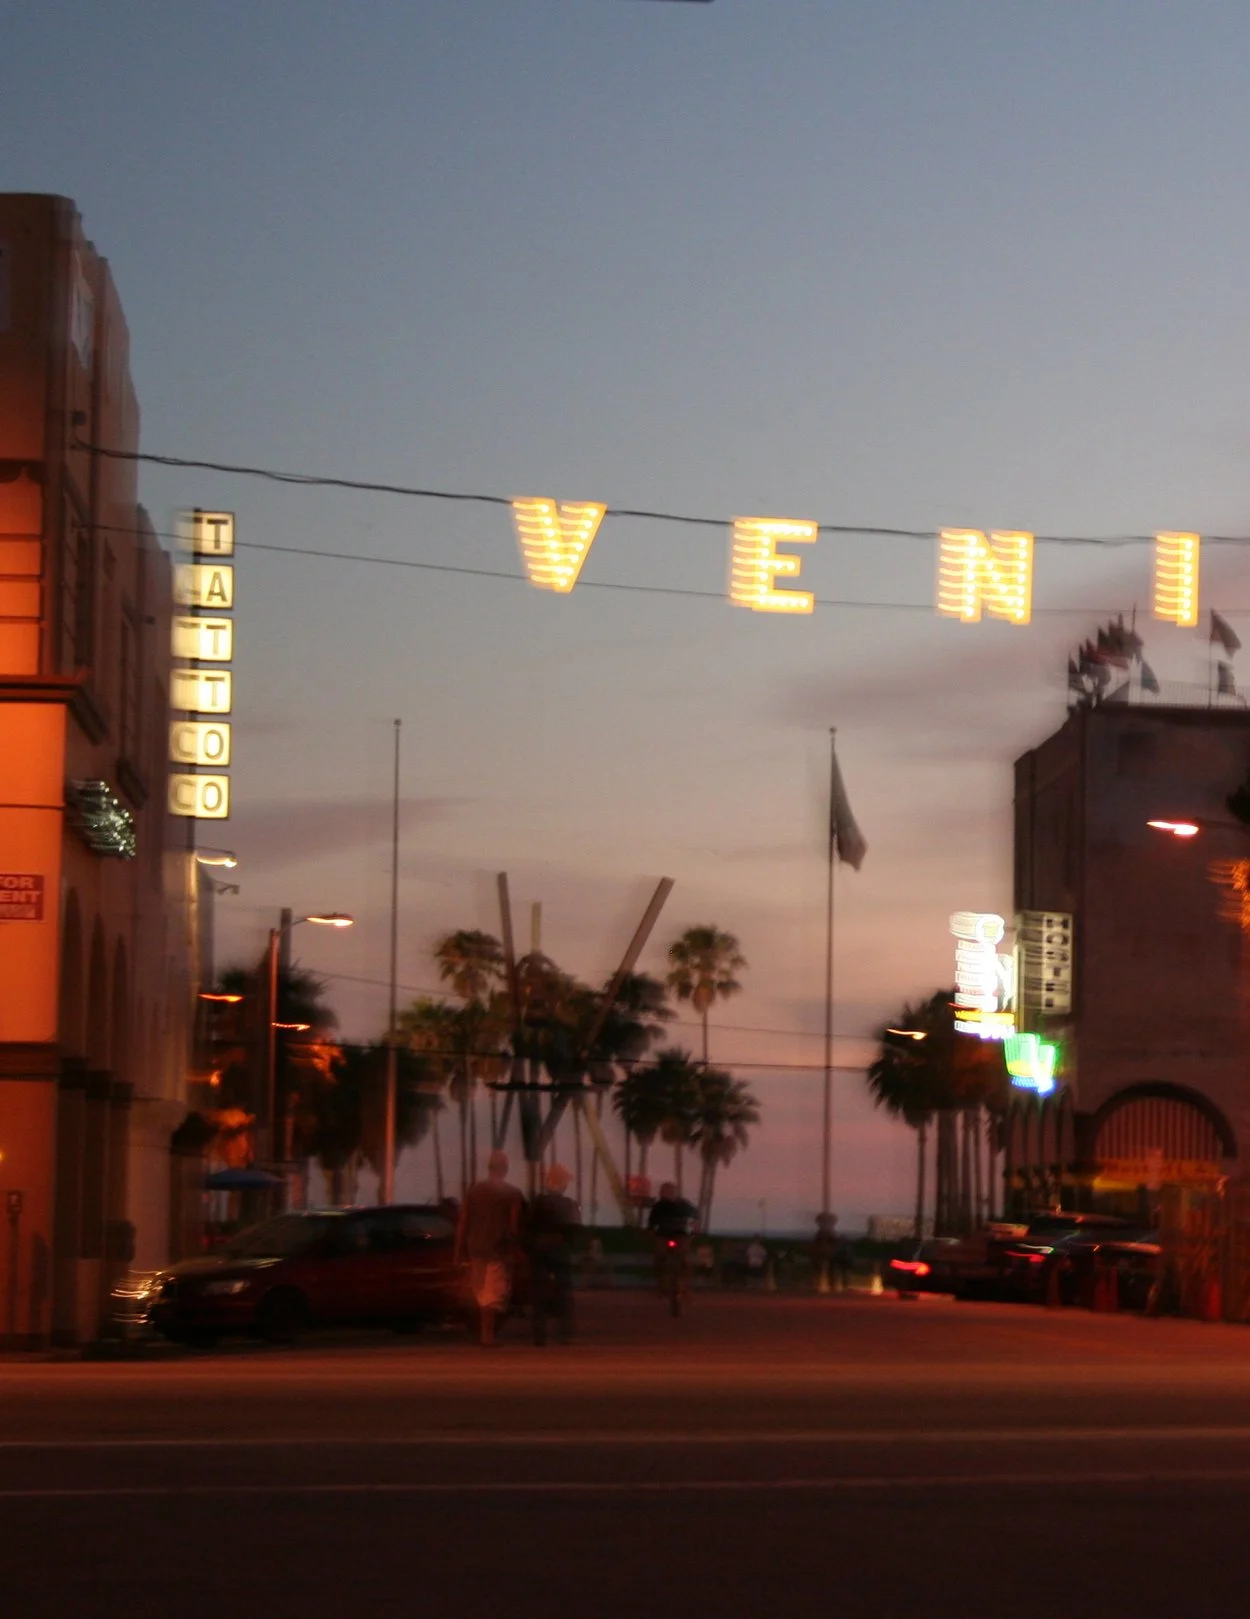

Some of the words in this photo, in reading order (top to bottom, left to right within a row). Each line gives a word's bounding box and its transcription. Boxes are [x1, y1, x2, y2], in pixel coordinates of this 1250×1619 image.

[198, 514, 233, 815] TATTOO
[0, 876, 34, 889] OR
[0, 890, 41, 903] ENT
